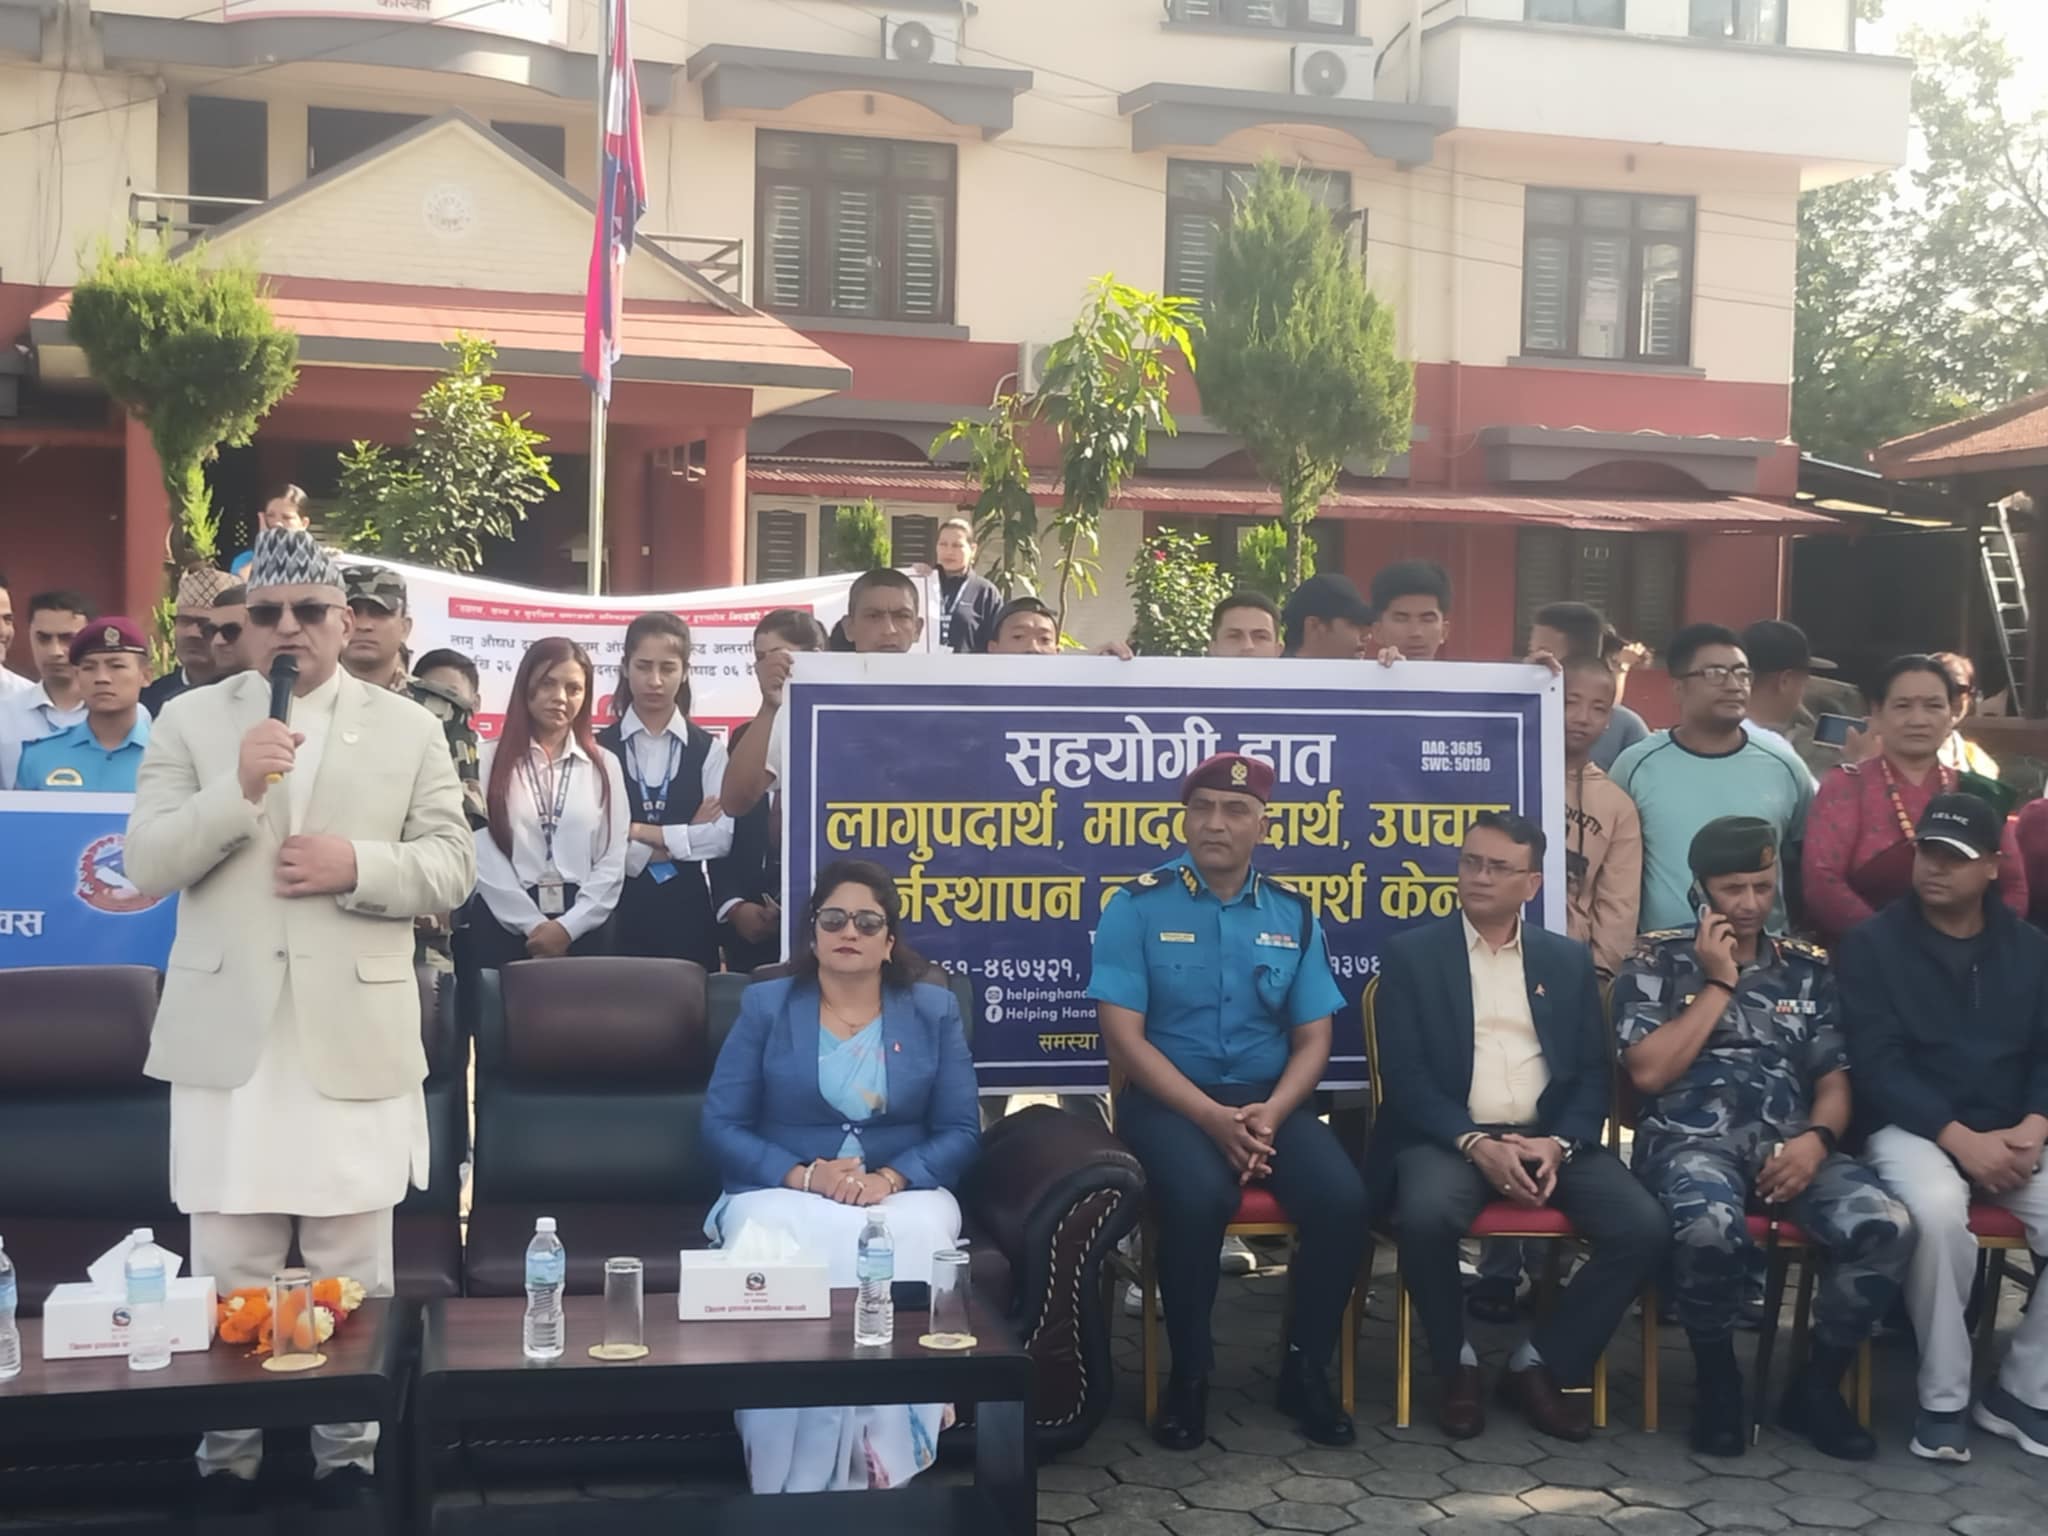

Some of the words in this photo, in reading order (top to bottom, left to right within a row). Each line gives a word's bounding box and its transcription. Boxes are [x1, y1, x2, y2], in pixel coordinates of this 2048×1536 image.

[1005, 715, 1221, 788] सहयोगी
[1421, 740, 1449, 755] DAO:
[1421, 757, 1453, 771] SWC:
[826, 788, 1064, 861] लागुपदार्थ,
[1264, 790, 1350, 850] दार्थ,
[1369, 803, 1511, 848] उपचा
[893, 864, 1085, 926] र्नस्थापन
[0, 911, 46, 937] वस
[929, 957, 1081, 982] ६१-४६७५२१,
[1006, 1007, 1058, 1021] Helping
[1038, 1033, 1099, 1053] समस्या
